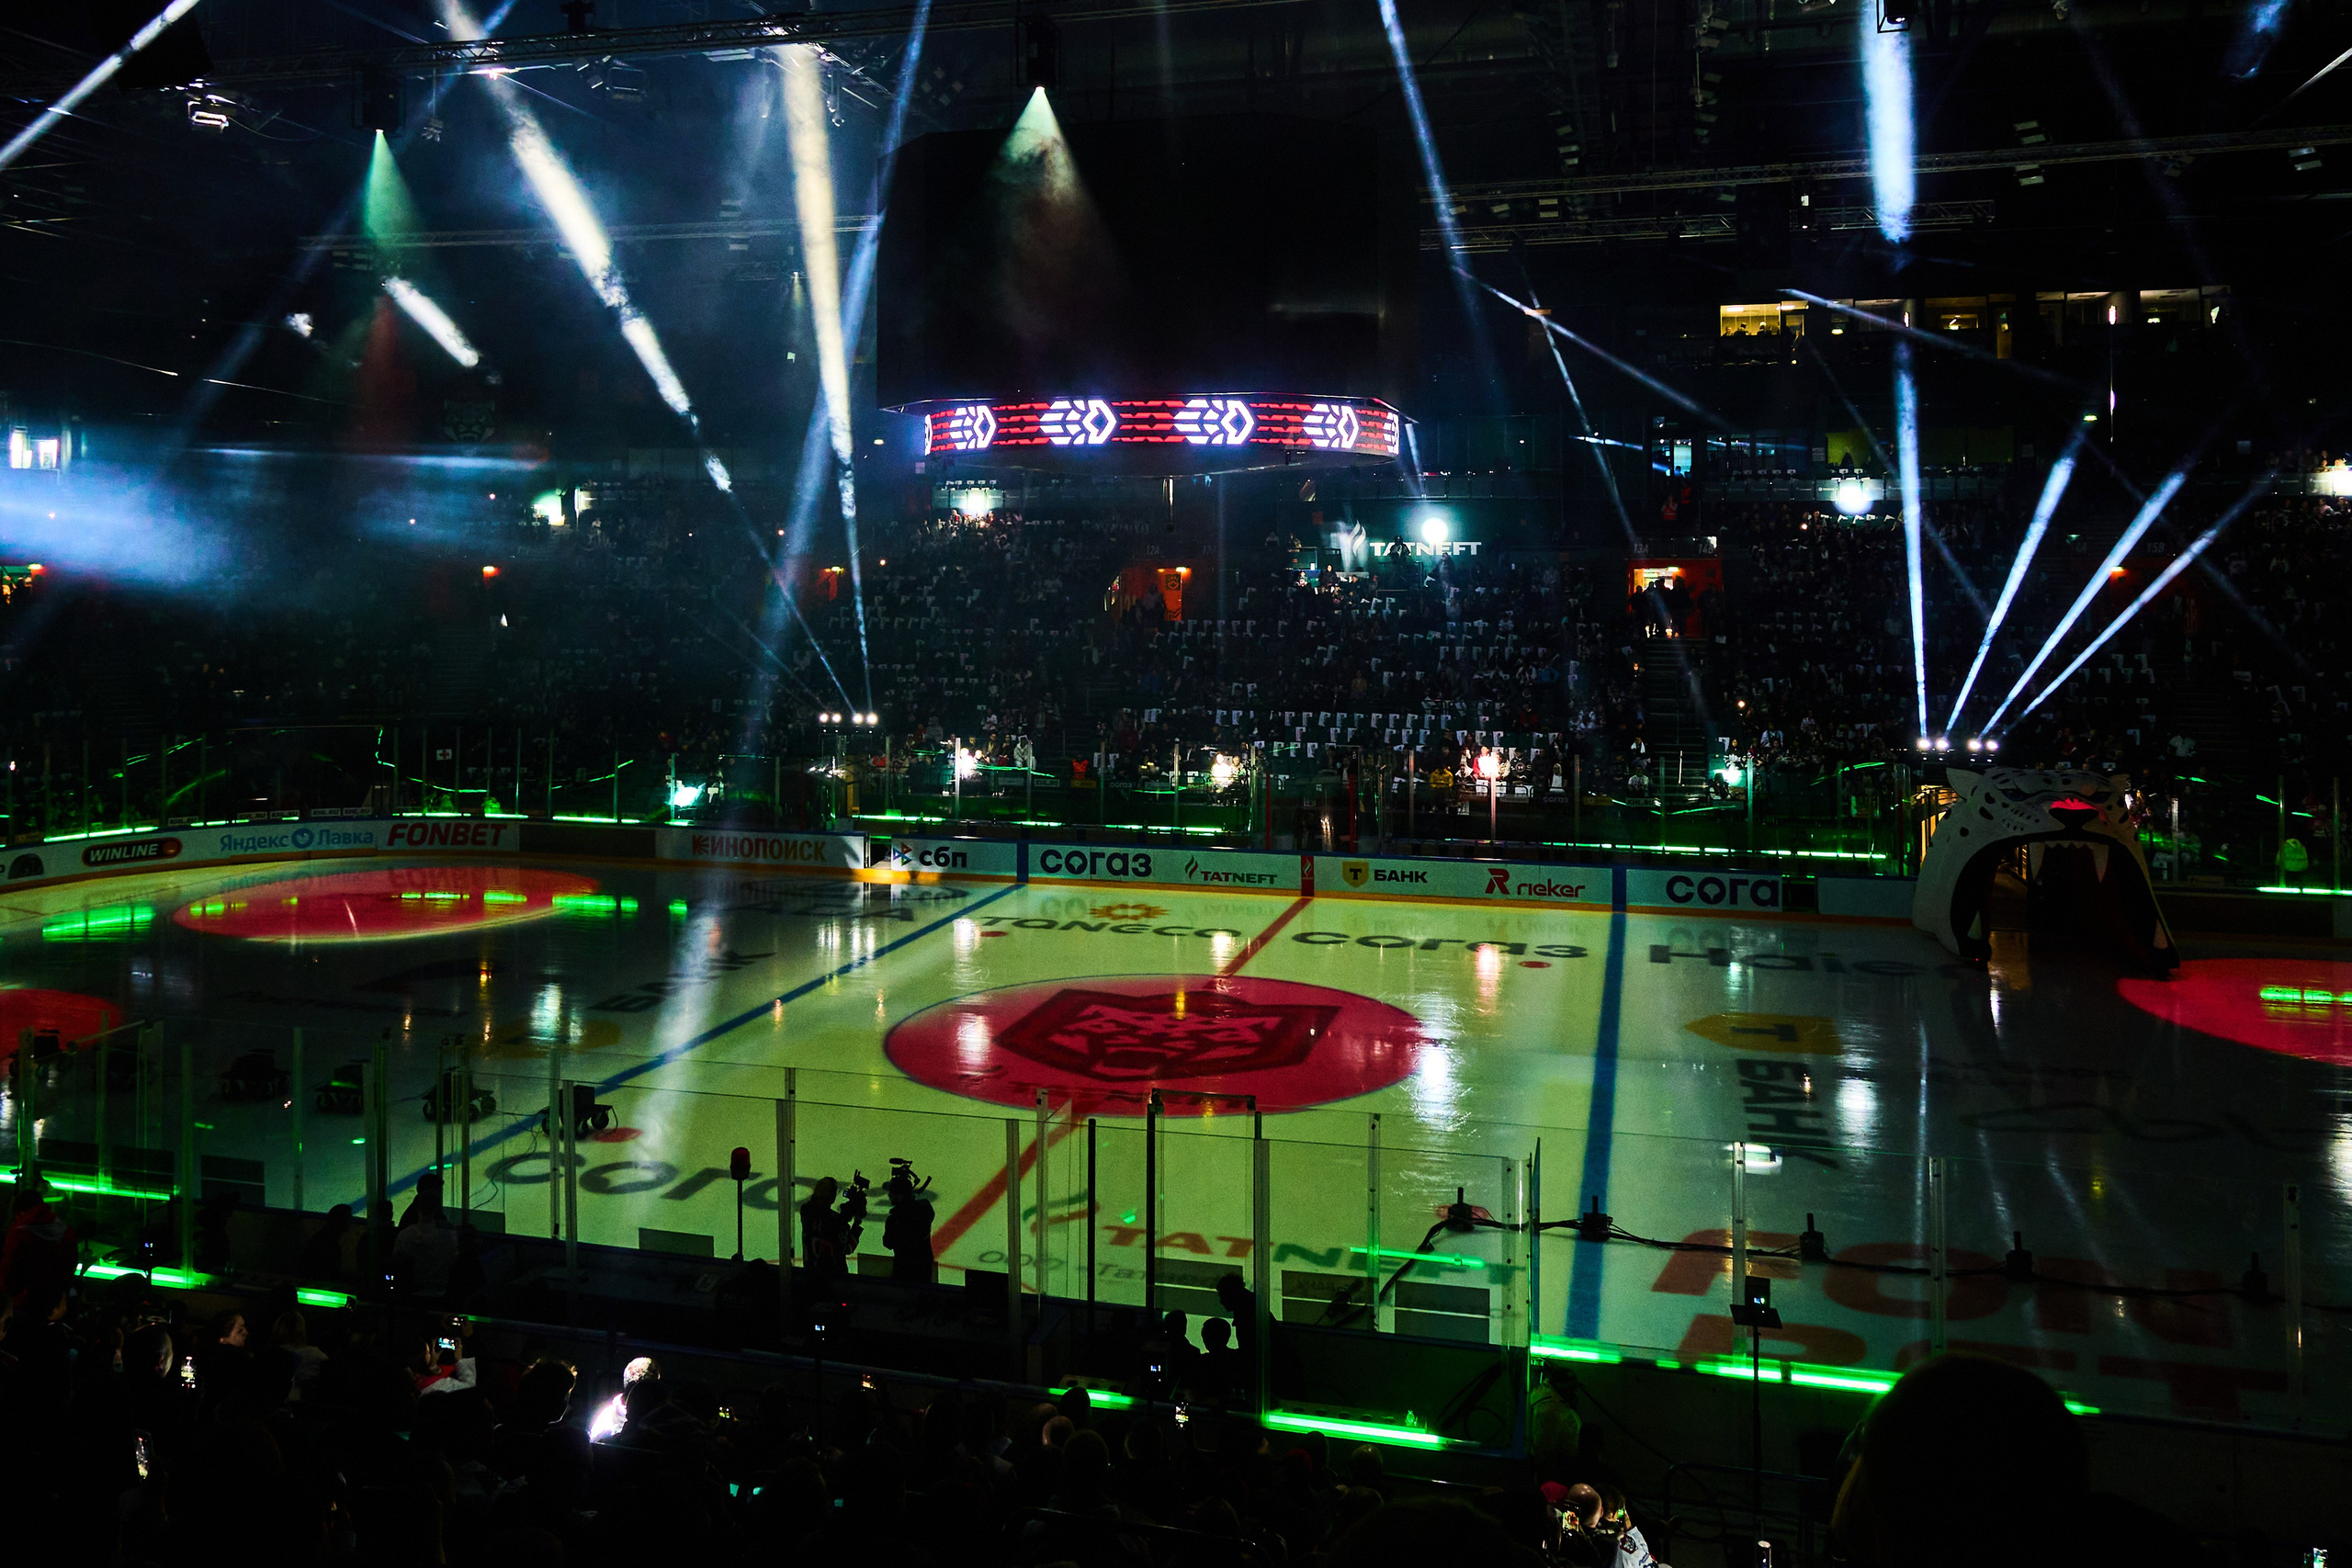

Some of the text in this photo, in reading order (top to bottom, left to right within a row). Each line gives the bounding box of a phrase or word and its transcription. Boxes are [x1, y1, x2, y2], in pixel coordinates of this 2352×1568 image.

[220, 829, 374, 852] Яндекс Лавка
[387, 823, 507, 847] FONBET
[89, 842, 159, 863] WINLINE
[692, 834, 826, 863] КИНОПОИСК
[919, 846, 967, 868] сбп
[1040, 849, 1152, 877] согаз
[1201, 871, 1278, 885] TATNEFT
[1374, 869, 1428, 884] БАНК
[1517, 878, 1586, 897] rieker
[1292, 931, 1588, 958] согаз
